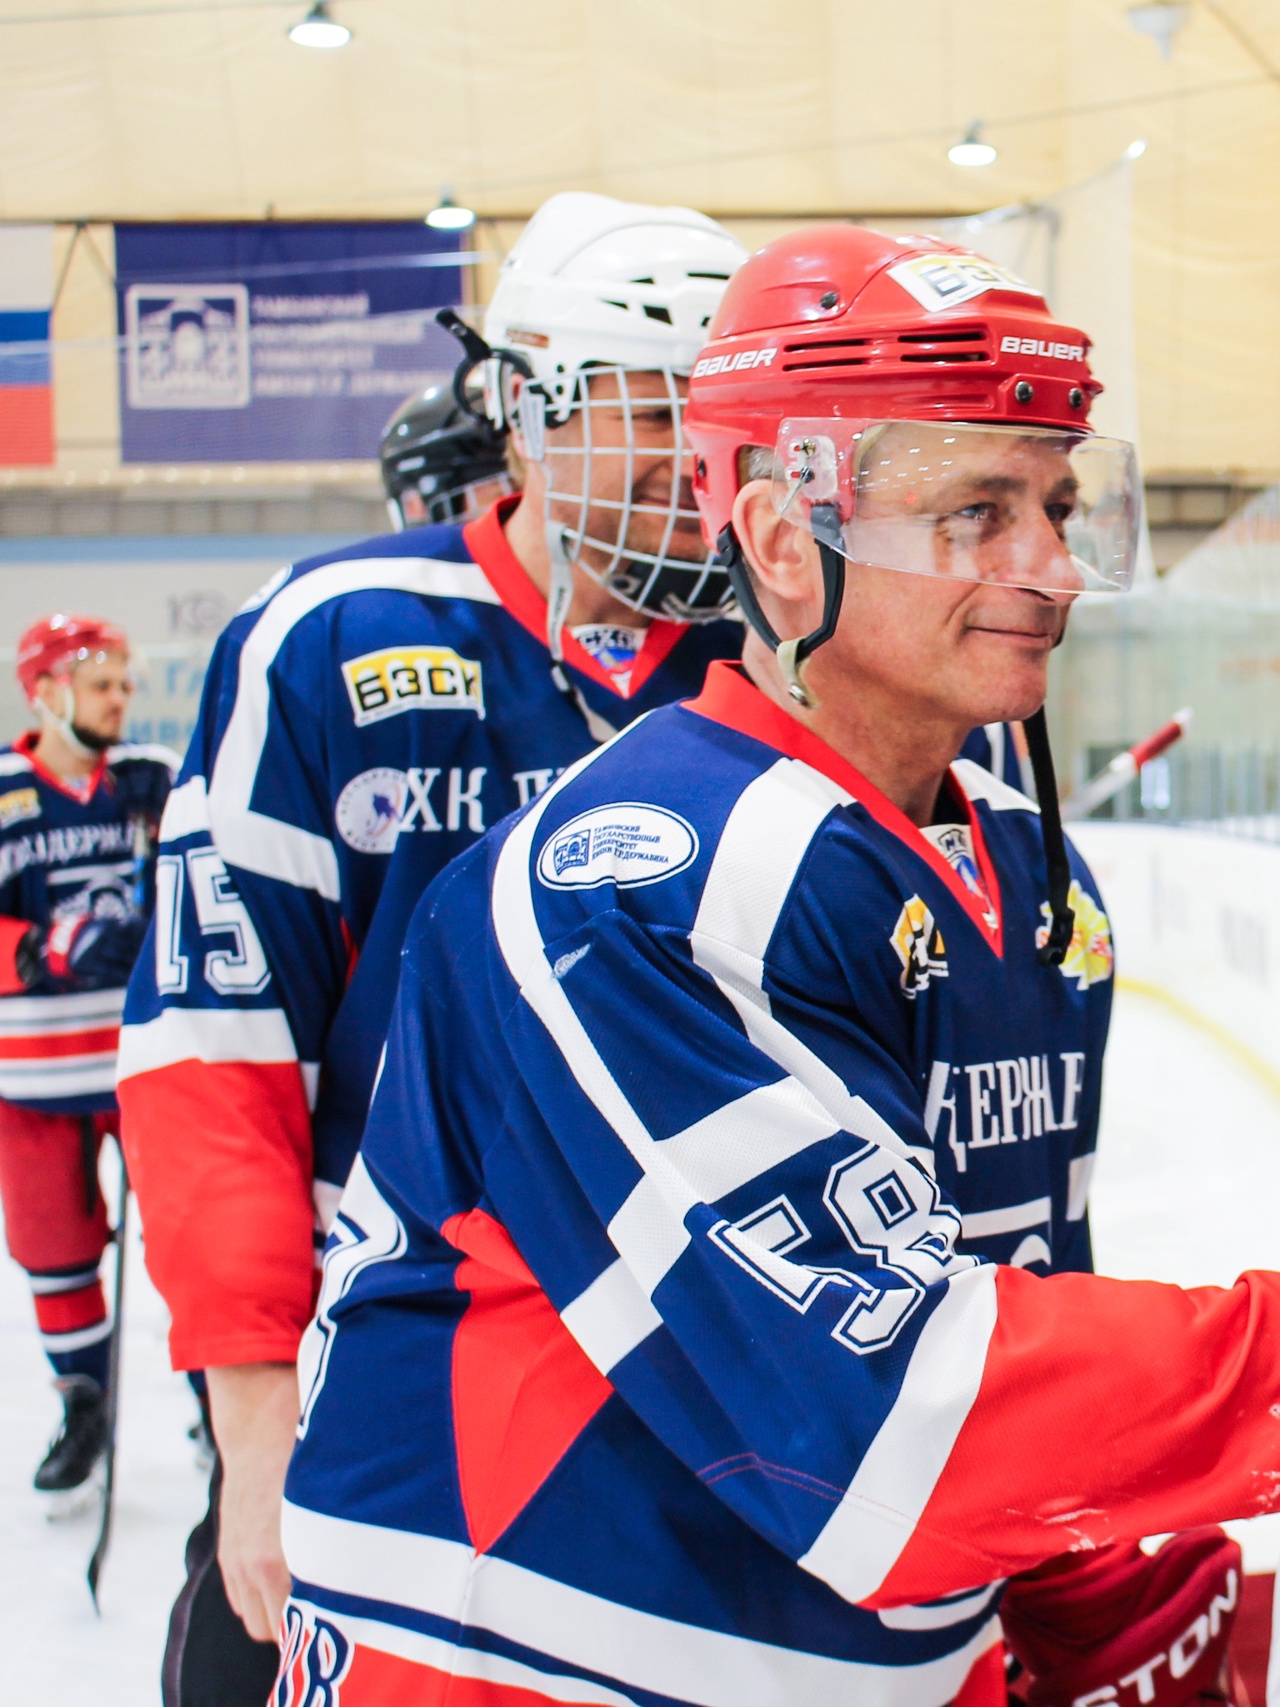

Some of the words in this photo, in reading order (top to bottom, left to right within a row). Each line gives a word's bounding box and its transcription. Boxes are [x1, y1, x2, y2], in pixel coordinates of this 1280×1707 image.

[692, 347, 777, 378] BAUER
[1001, 337, 1085, 360] BAUER
[398, 767, 487, 833] ХК
[155, 845, 272, 996] 15
